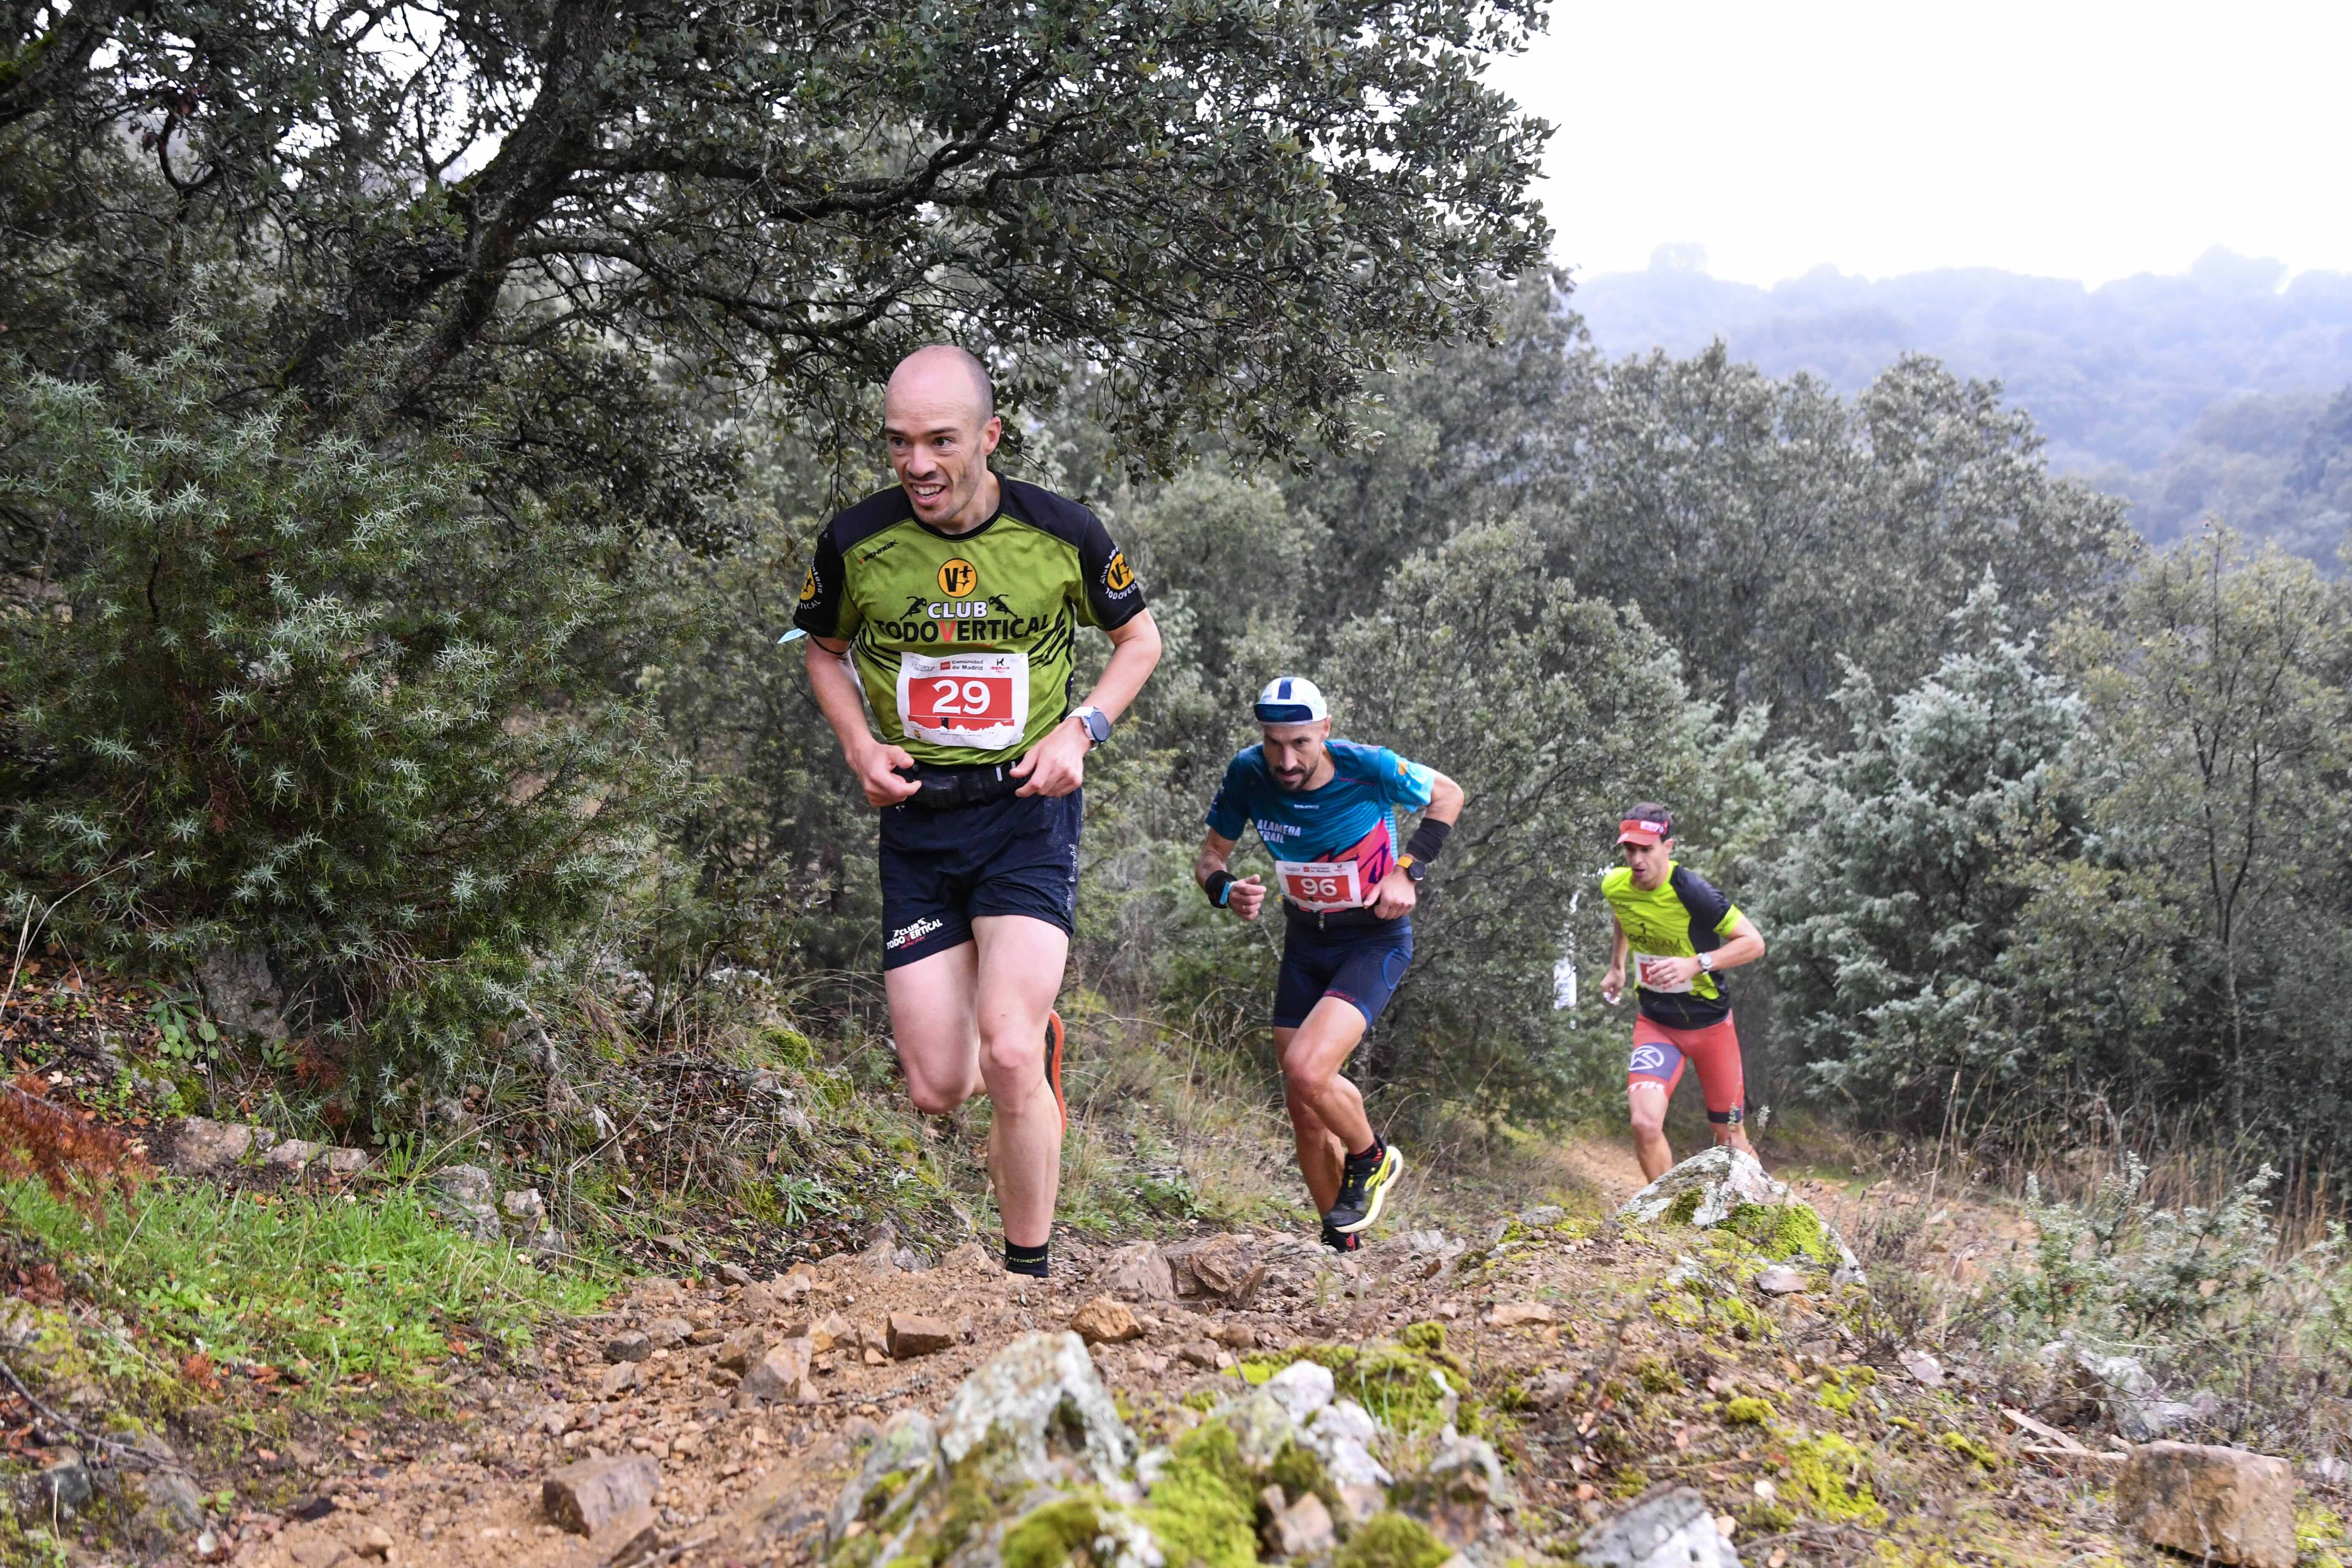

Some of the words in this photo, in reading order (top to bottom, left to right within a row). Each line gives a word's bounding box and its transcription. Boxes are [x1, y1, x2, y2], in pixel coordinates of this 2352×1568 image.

[927, 601, 988, 619] CLUB
[874, 614, 1048, 642] TODOVERTICAL
[932, 679, 991, 715] 29
[1257, 819, 1301, 837] ALAMEDA
[1301, 878, 1337, 896] 96
[886, 919, 943, 950] TODOVERTICAL
[899, 923, 920, 936] CLUB
